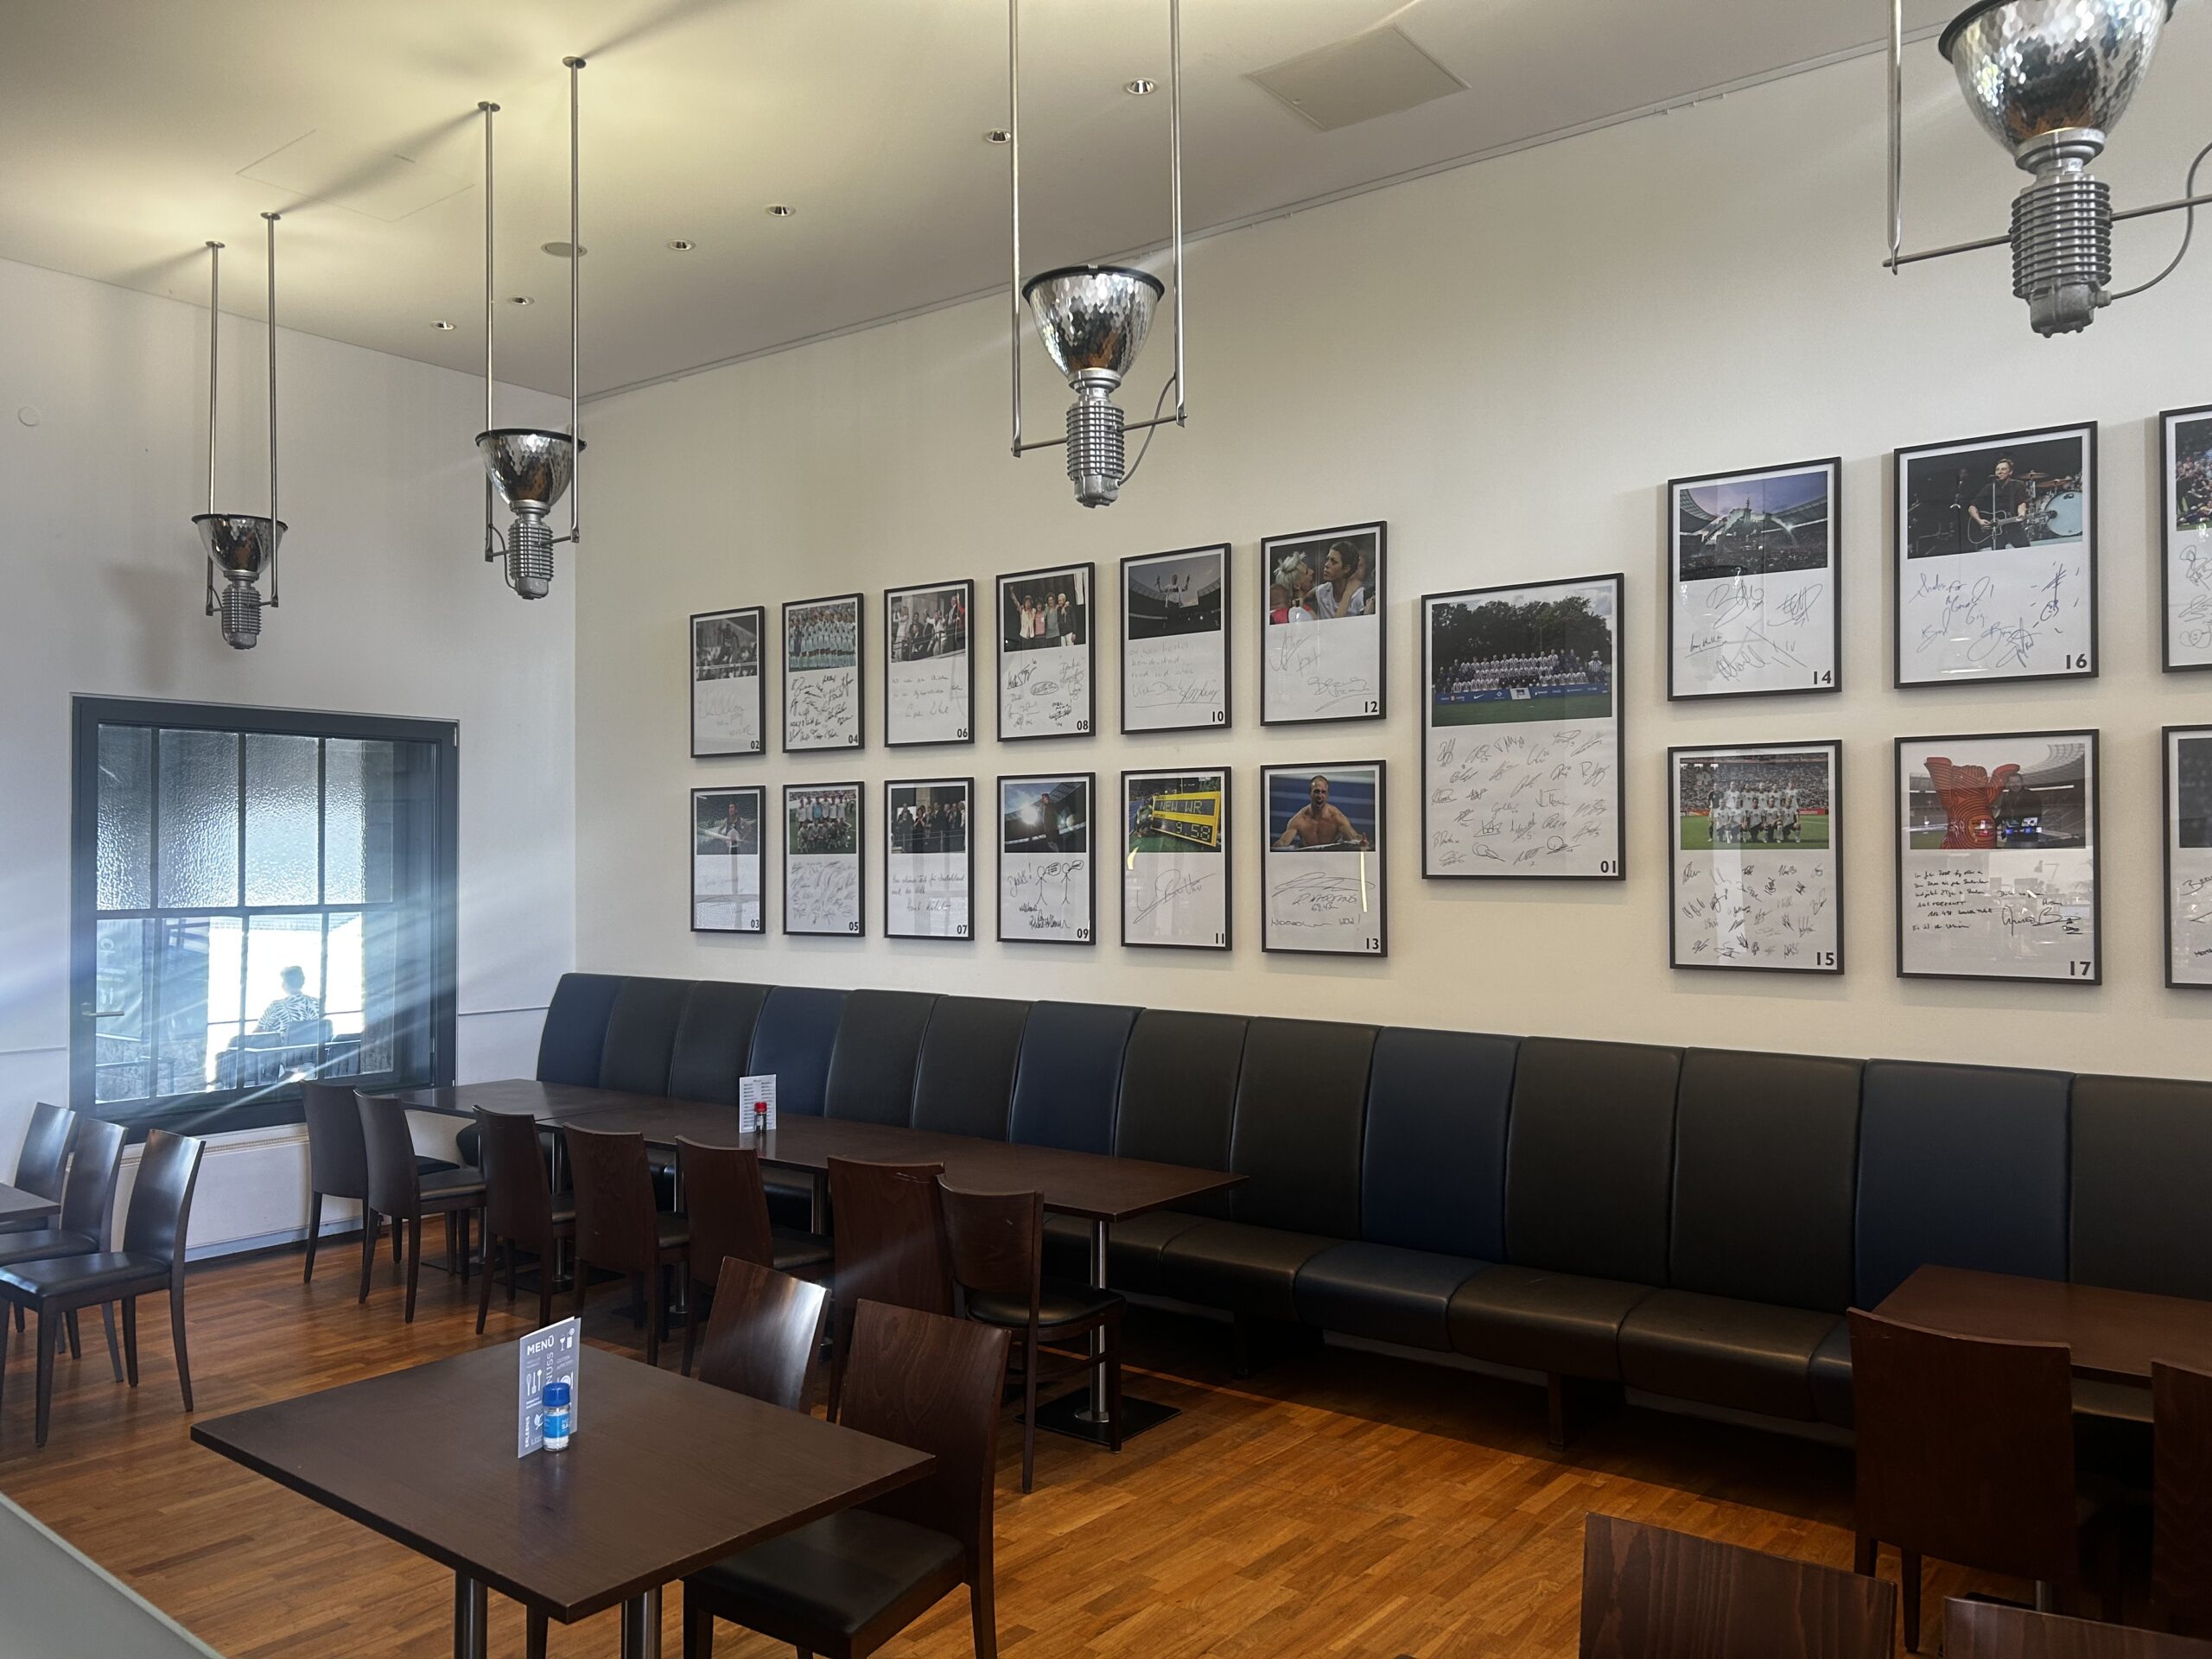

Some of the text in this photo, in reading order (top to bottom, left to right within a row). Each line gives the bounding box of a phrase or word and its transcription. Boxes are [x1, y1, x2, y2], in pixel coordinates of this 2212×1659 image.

[2066, 653, 2088, 670] 16
[1813, 671, 1832, 684] 14
[1364, 701, 1378, 713] 12
[1212, 710, 1224, 722] 10
[1077, 720, 1089, 730] 08
[849, 734, 859, 744] 04
[957, 728, 968, 738] 06
[750, 740, 760, 749] 02
[1160, 800, 1202, 814] NEW WR
[1175, 821, 1211, 841] 9.58
[1600, 860, 1617, 874] 01
[750, 918, 760, 929] 03
[849, 921, 859, 931] 05
[957, 925, 968, 935] 07
[1077, 928, 1089, 939] 09
[1215, 932, 1224, 944] 11
[1365, 938, 1379, 950] 13
[1816, 951, 1834, 966] 15
[2069, 961, 2091, 976] 17
[527, 1335, 554, 1356] MENÜ
